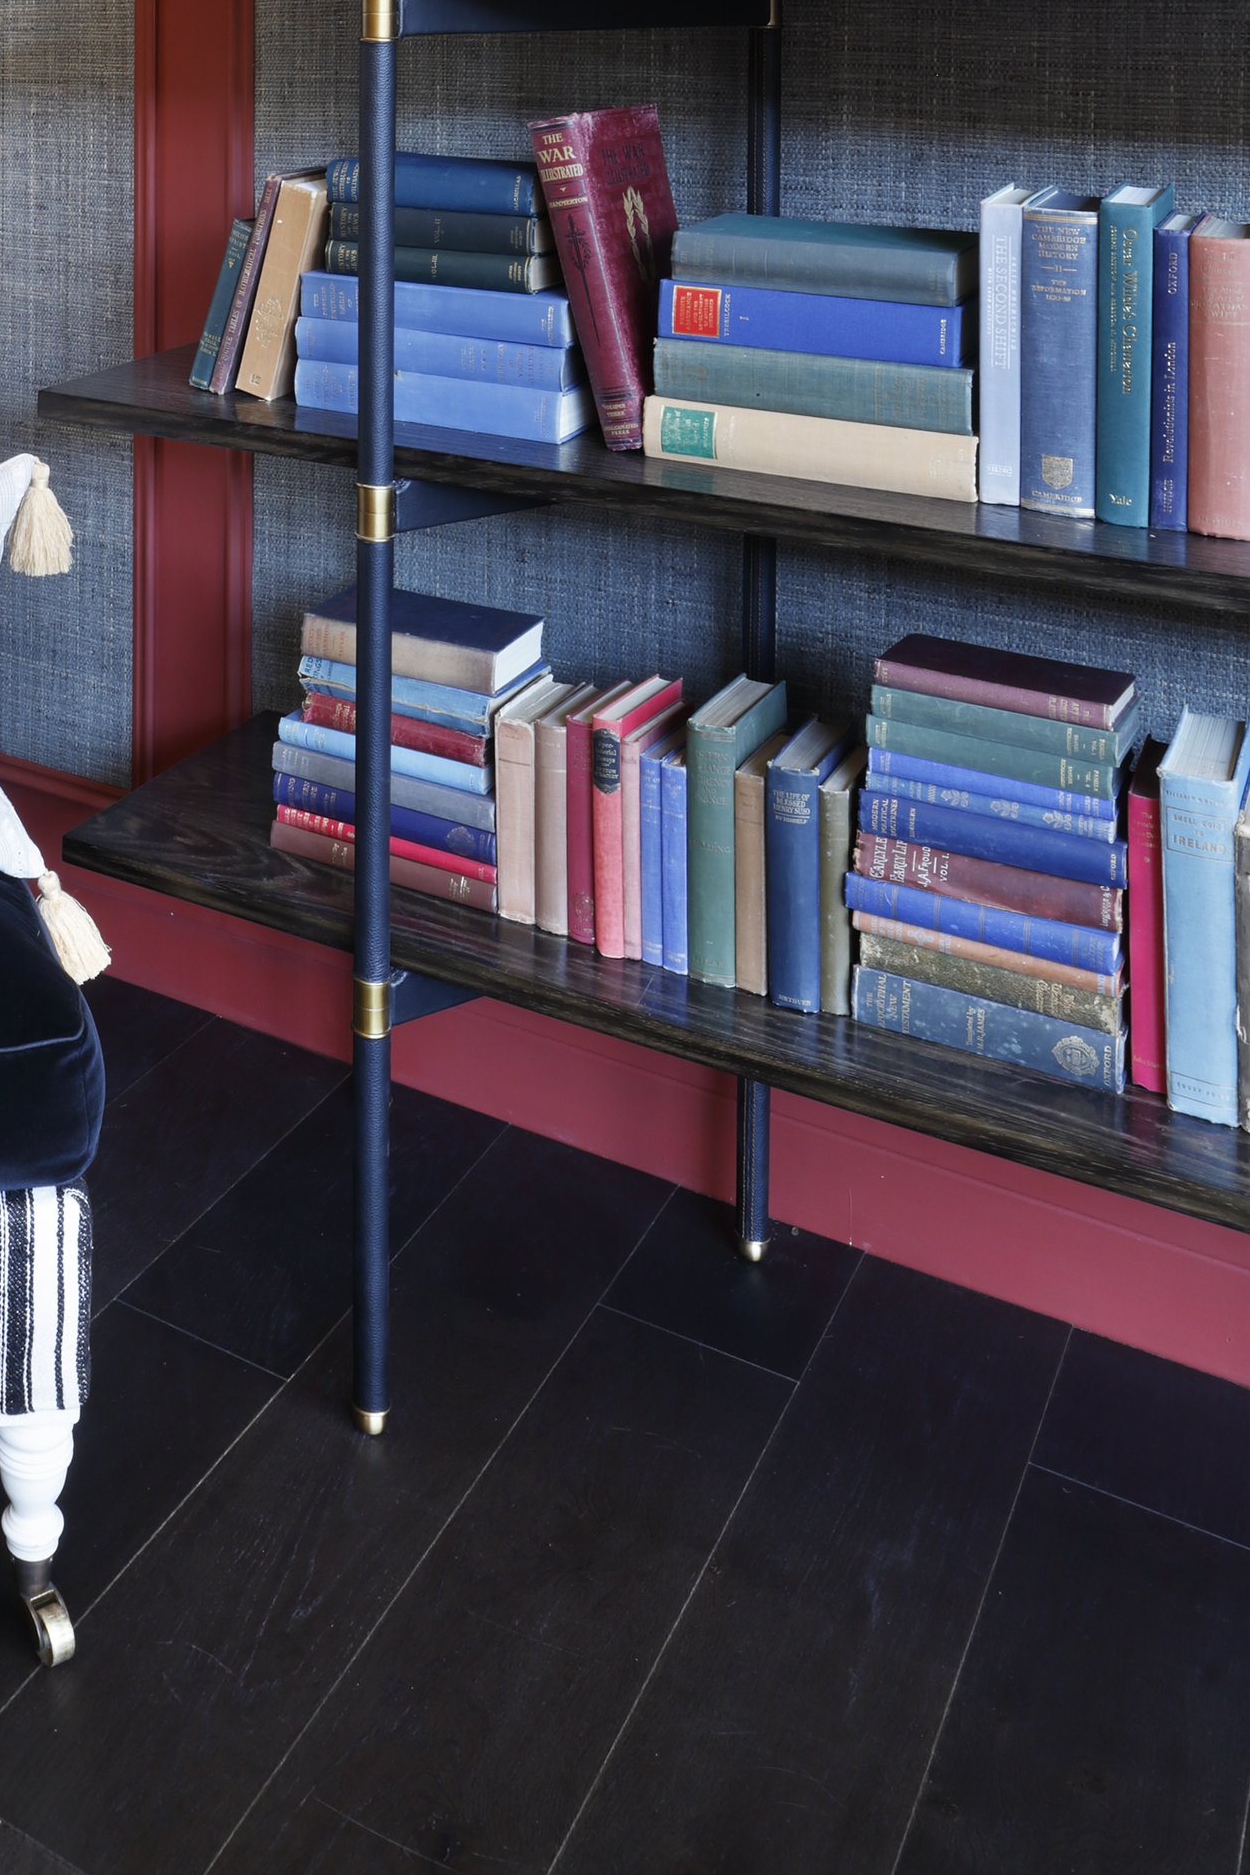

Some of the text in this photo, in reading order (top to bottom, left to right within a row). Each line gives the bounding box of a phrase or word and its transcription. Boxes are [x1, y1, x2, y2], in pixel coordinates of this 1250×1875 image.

[541, 133, 564, 145] THE
[537, 145, 577, 164] WAR
[540, 163, 584, 183] ILLUSTRATED
[549, 196, 589, 208] HAMMERTON
[1036, 224, 1080, 236] THE NEW
[1032, 233, 1087, 244] CAMBRIDGE
[1038, 242, 1079, 252] MODERN
[1038, 250, 1079, 261] HISTORY
[1167, 251, 1178, 295] OXFORD
[1031, 284, 1087, 296] REFORMATION
[1051, 278, 1067, 286] THE
[994, 236, 1008, 369] THE SECOND SHIFT
[939, 318, 947, 355] CAMBRIDGE
[1163, 341, 1177, 380] London
[1161, 394, 1177, 463] Revolutionists
[1031, 490, 1083, 503] CAMBRIDGE
[1109, 493, 1133, 506] Yale
[801, 793, 811, 802] OF
[1173, 834, 1227, 854] IRELAND
[889, 849, 908, 884] EARLY
[888, 993, 898, 1021] NEW
[1103, 1044, 1113, 1087] OXFORD
